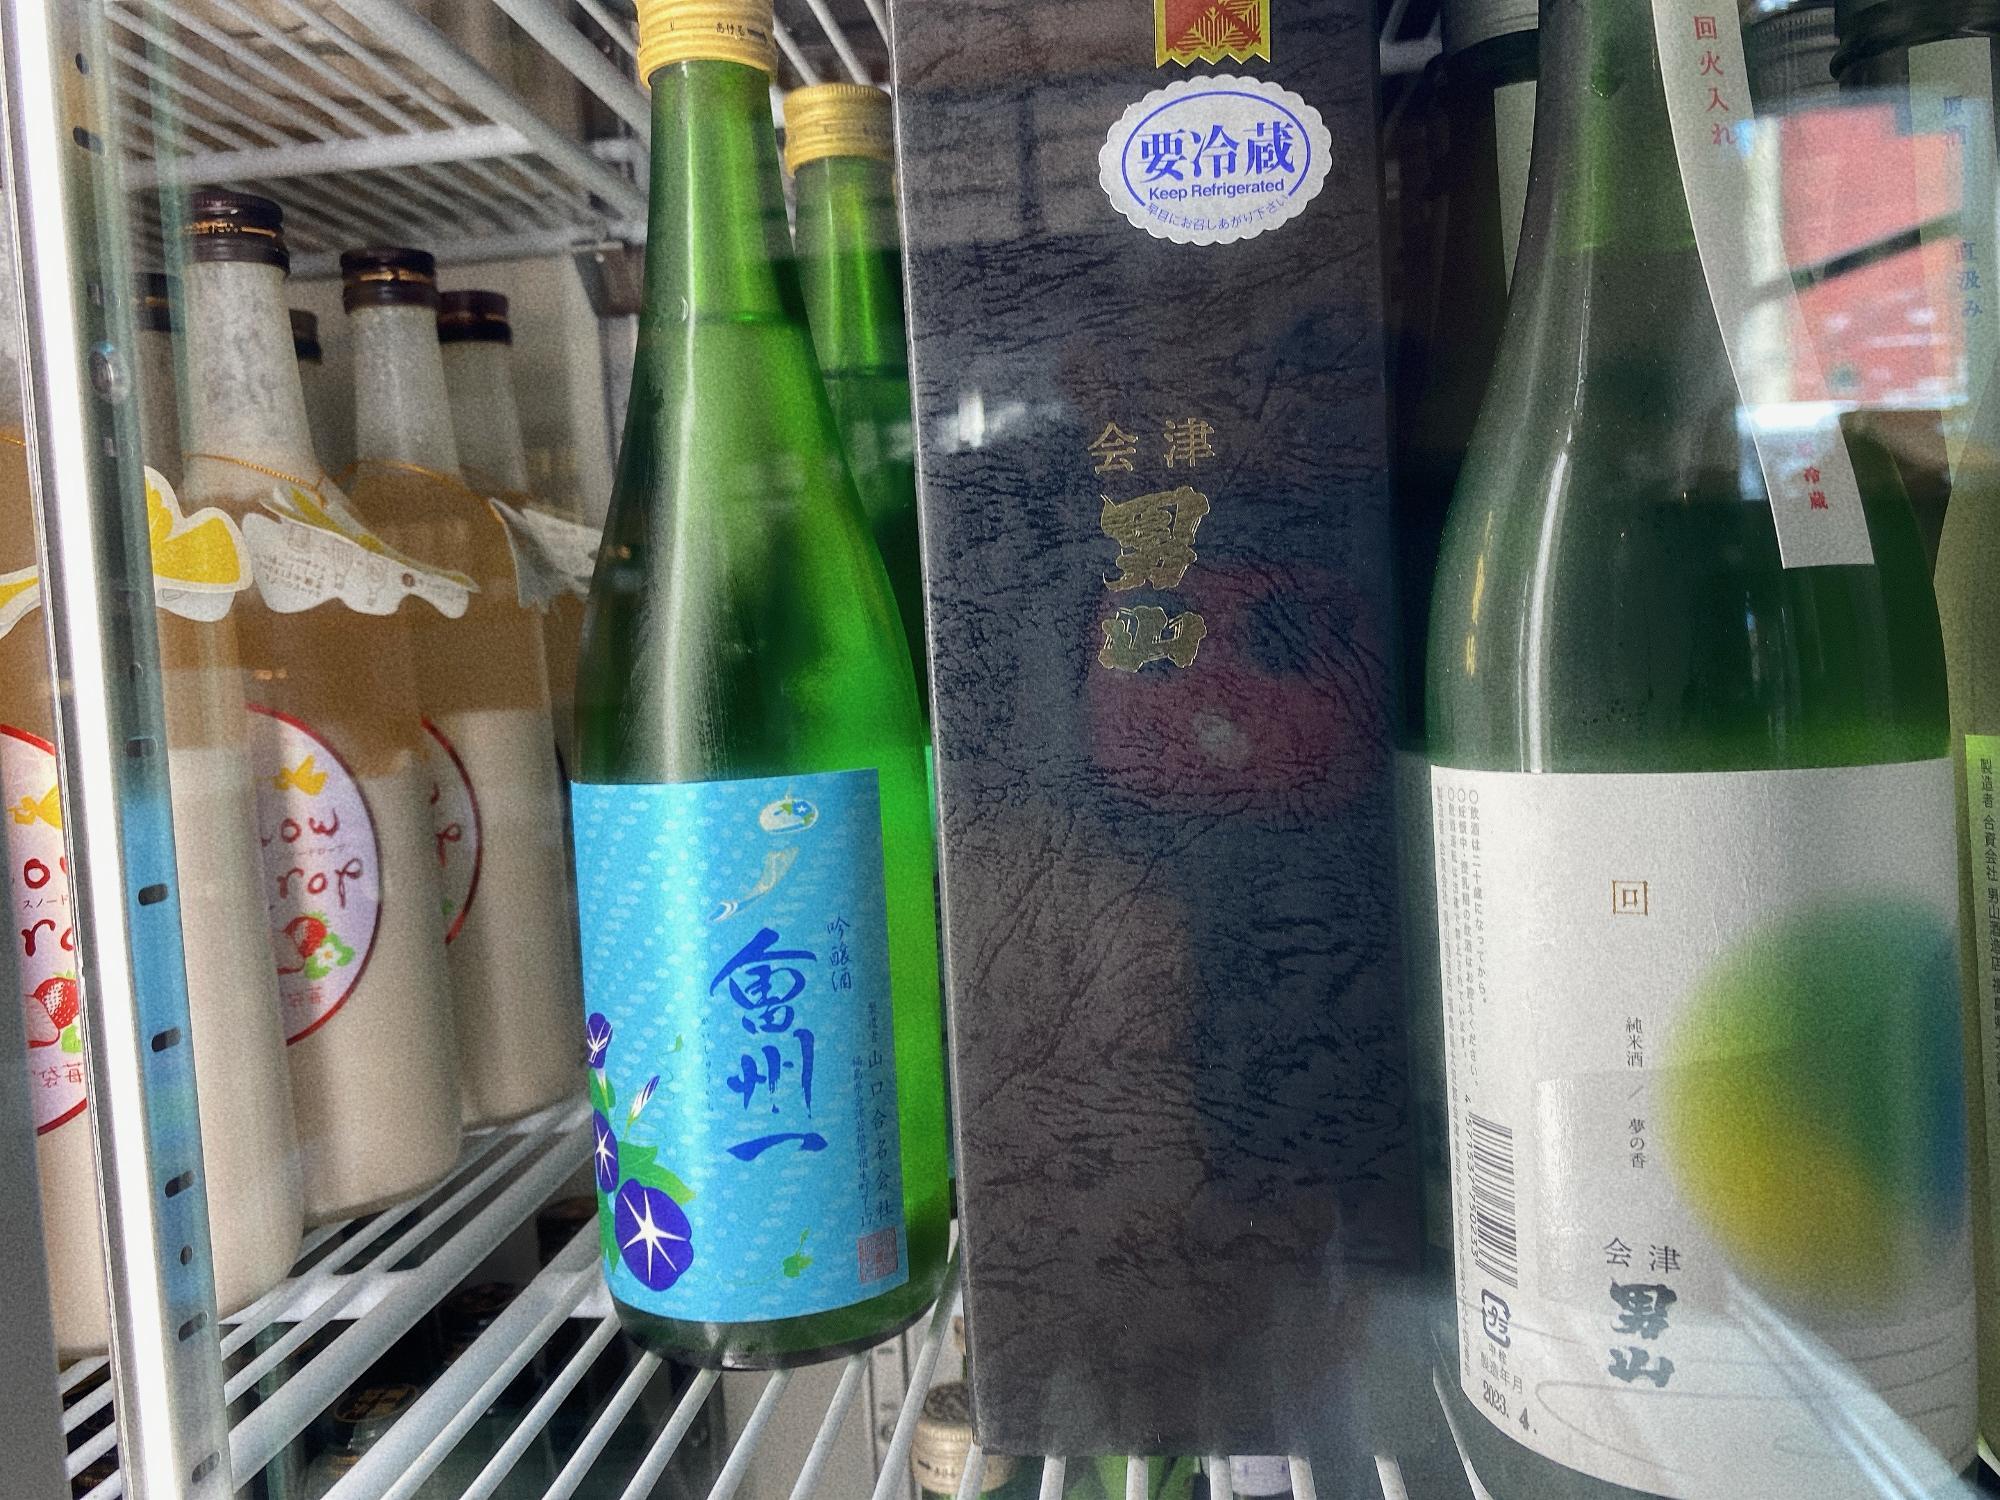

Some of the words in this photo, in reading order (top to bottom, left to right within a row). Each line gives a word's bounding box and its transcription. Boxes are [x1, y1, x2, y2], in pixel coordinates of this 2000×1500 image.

[1137, 121, 1296, 183] 要冷蔵
[1145, 193, 1290, 231] 早目にお召しあがり下さい
[1149, 186, 1188, 202] Keep
[1191, 178, 1285, 199] Refrigerated
[1087, 417, 1216, 475] 会津
[1980, 758, 1995, 809] 製造者
[1983, 814, 1999, 882] 合資会社
[827, 915, 852, 992] 吟醸酒
[1626, 1016, 1643, 1067] 純米酒
[1629, 1118, 1647, 1169] 夢の香
[1604, 1237, 1681, 1274] 会津
[1480, 1350, 1523, 1394] 製造年月
